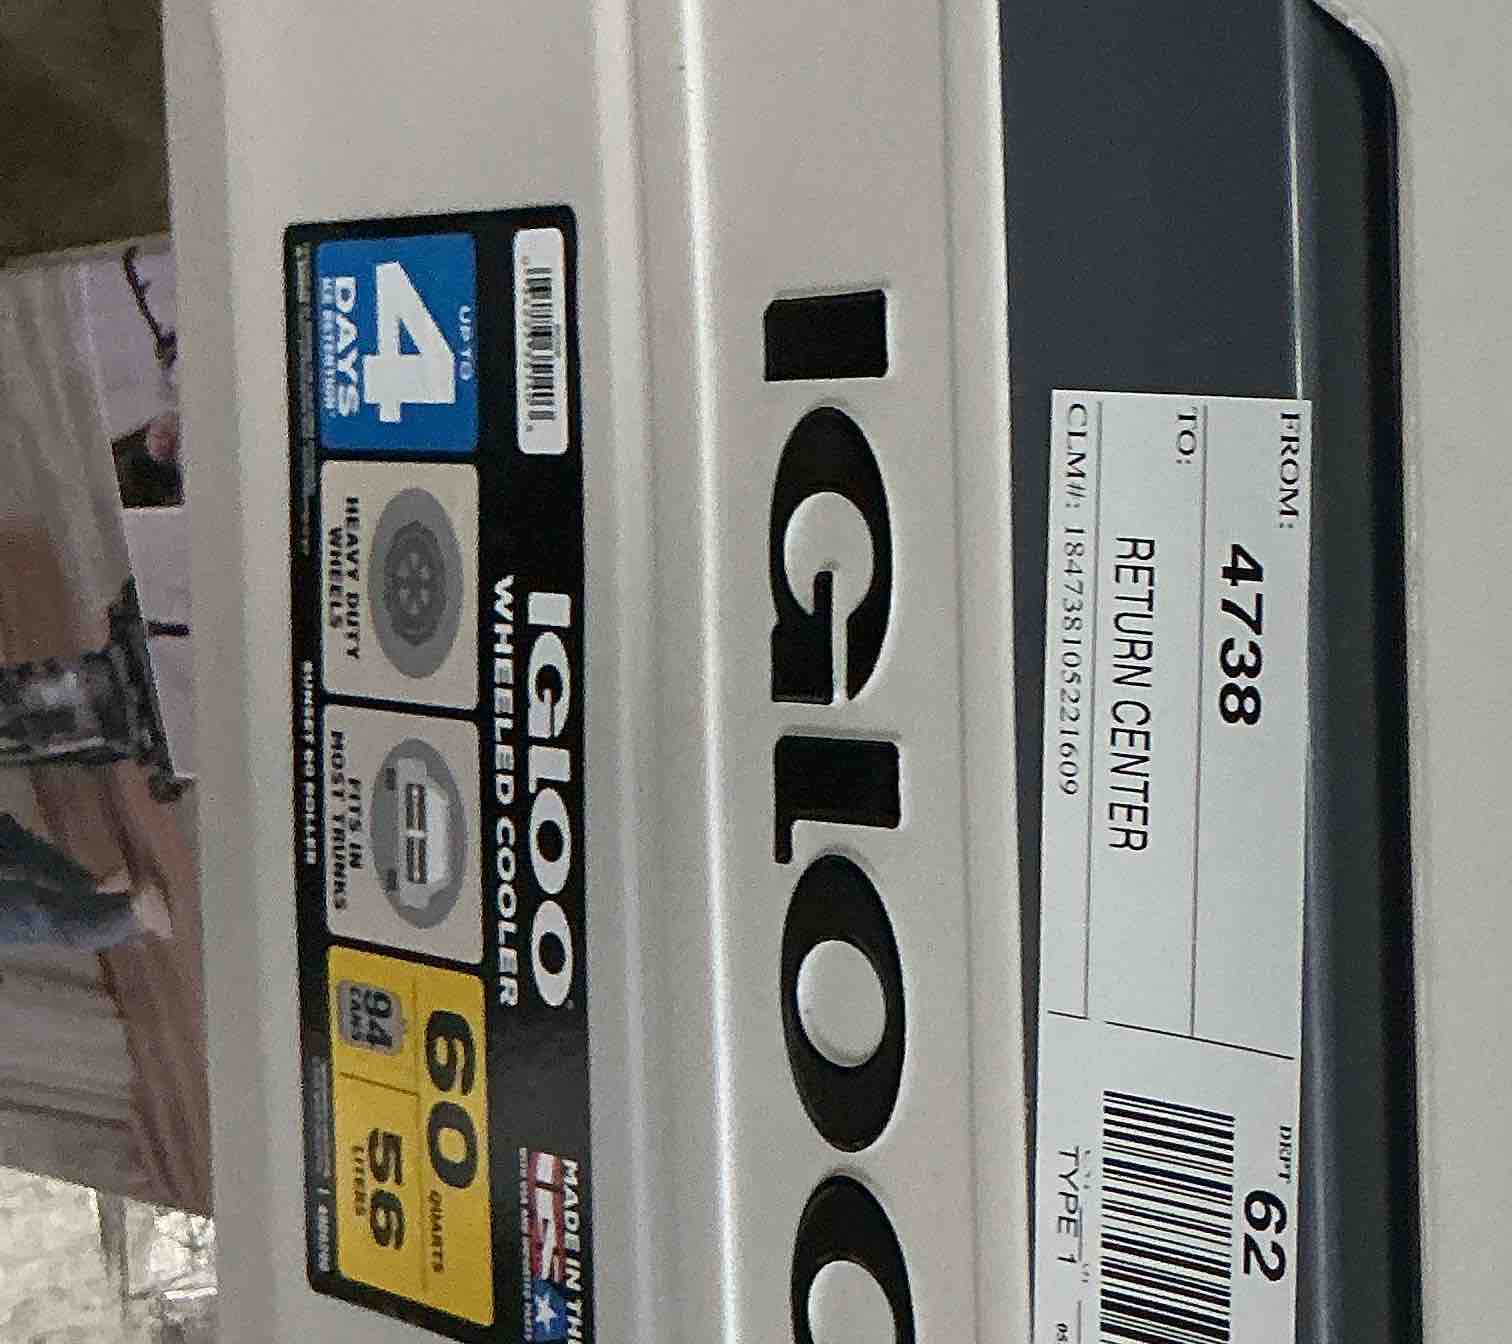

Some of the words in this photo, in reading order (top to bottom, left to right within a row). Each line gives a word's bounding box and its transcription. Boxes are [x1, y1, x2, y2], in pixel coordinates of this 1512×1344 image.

[335, 275, 360, 418] DAYS
[362, 260, 457, 423] 4
[458, 305, 472, 344] UP
[458, 349, 472, 381] TO
[1064, 402, 1089, 510] CLM#:
[1175, 409, 1198, 466] TO:
[1278, 412, 1301, 530] FROM:
[328, 526, 344, 630] WHEELS
[344, 496, 360, 582] HEAVY
[345, 593, 361, 660] DUTY
[1111, 536, 1155, 690] RETURN
[1219, 543, 1265, 727] 4738
[493, 575, 516, 806] WHEELED
[1058, 524, 1086, 797] 184738105221609
[331, 730, 346, 802] MOST
[347, 778, 362, 834] FITS
[527, 592, 574, 1007] IGLOO
[1107, 699, 1151, 852] CENTER
[305, 782, 317, 865] ROLLER
[332, 813, 348, 910] TRUNKS
[348, 843, 363, 869] IN
[496, 817, 520, 1006] COOLER
[349, 986, 364, 1042] CANS
[363, 989, 394, 1048] 94
[425, 1010, 478, 1189] 60
[352, 1145, 367, 1216] LITERS
[368, 1127, 405, 1250] 56
[1056, 1145, 1080, 1238] TYPE
[1277, 1125, 1293, 1185] DEPT
[427, 1189, 445, 1273] QUARTS
[563, 1159, 580, 1247] MADE
[1243, 1189, 1288, 1282] 62
[564, 1257, 582, 1291] IN
[1056, 1253, 1078, 1265] 1
